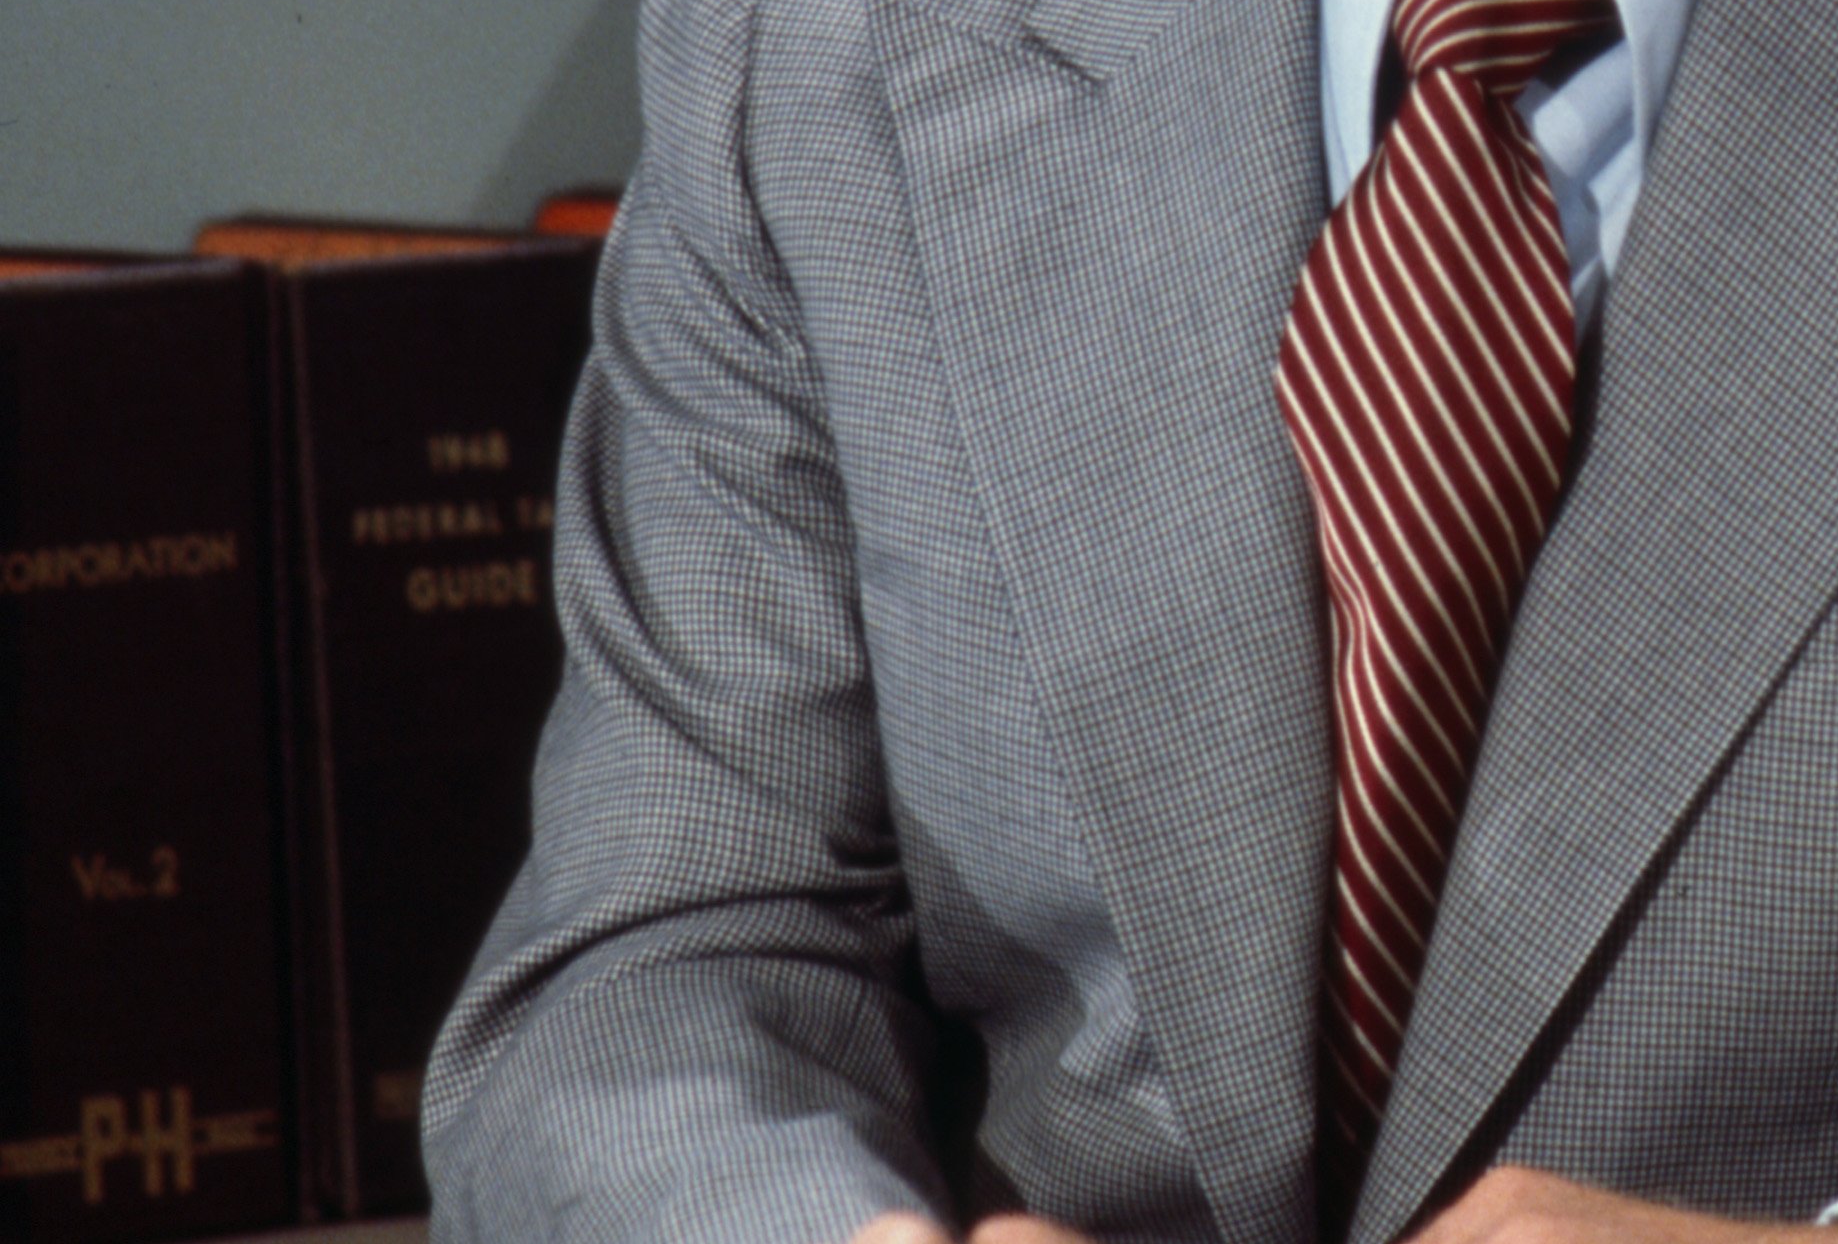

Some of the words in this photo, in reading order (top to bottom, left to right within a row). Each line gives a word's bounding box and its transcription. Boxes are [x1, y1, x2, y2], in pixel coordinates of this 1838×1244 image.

[353, 500, 503, 546] FEDERAL
[515, 494, 554, 532] TA
[0, 531, 239, 594] ORPORATION
[406, 558, 537, 613] GUIDE
[150, 844, 182, 897] 2
